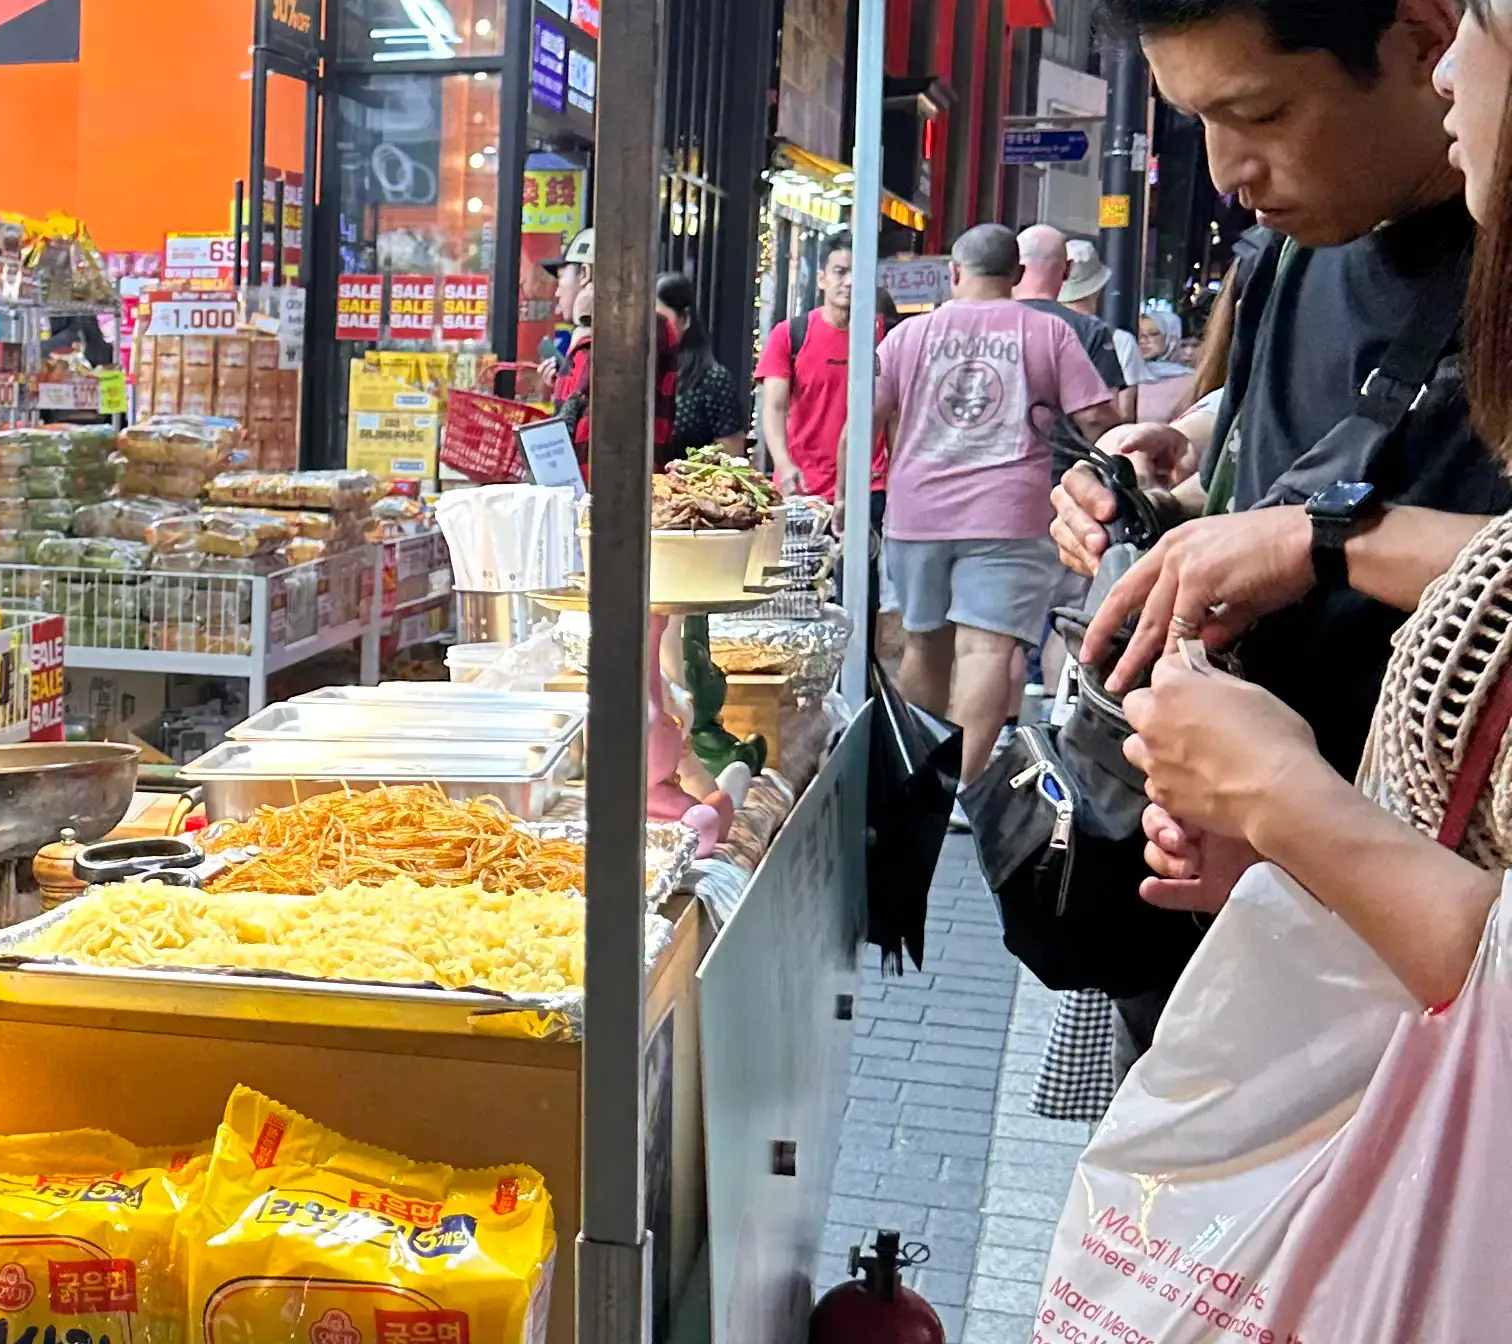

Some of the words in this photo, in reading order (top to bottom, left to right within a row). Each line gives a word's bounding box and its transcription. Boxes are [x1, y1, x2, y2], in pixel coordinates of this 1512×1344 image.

[339, 284, 381, 298] SALE
[392, 284, 435, 298] SALE
[444, 284, 488, 298] SALE
[339, 299, 380, 313] SALE
[391, 299, 434, 313] SALE
[444, 299, 487, 313] SALE
[338, 314, 380, 328] SALE
[390, 314, 433, 328] SALE
[442, 314, 487, 329] SALE
[31, 637, 63, 671] SALE
[31, 668, 63, 701] SALE
[31, 697, 63, 733] SALE
[355, 1190, 438, 1229] 굵은면
[1097, 1206, 1171, 1258] Mardi
[1080, 1233, 1136, 1277] where
[1160, 1281, 1180, 1302] as
[57, 1270, 133, 1305] 굵은면
[1049, 1276, 1102, 1323] Mardi
